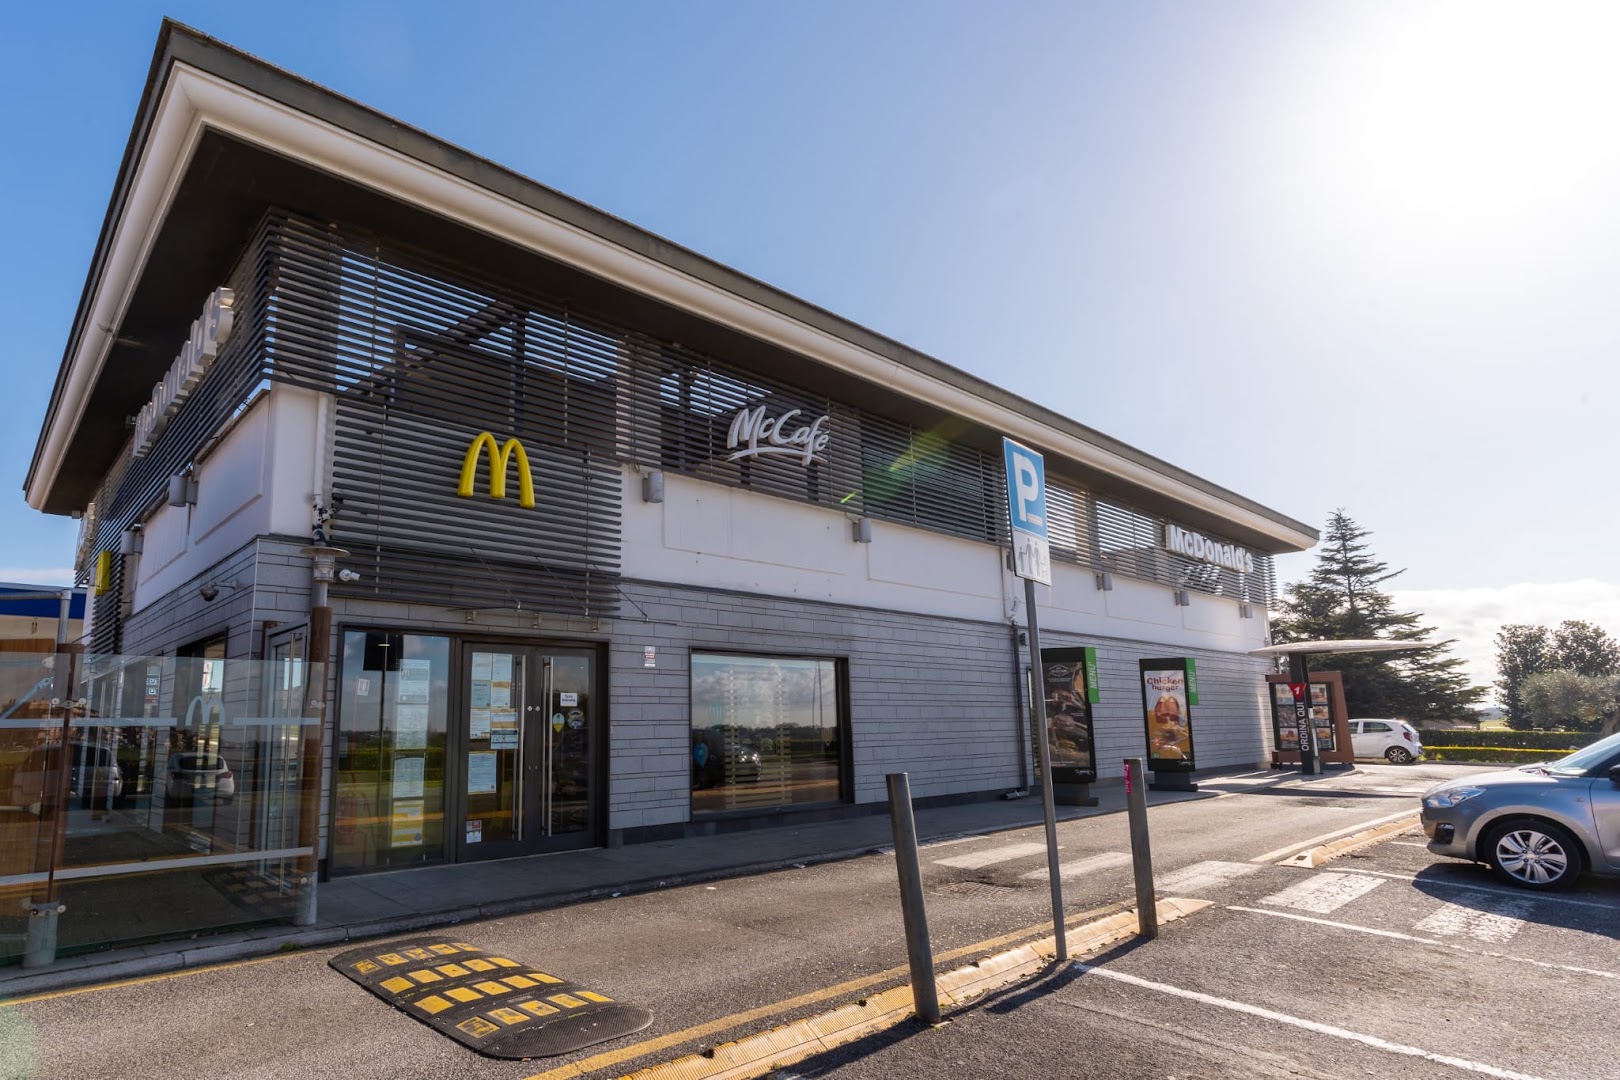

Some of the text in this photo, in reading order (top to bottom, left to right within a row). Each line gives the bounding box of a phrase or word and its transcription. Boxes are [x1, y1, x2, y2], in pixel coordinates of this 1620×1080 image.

[727, 405, 829, 466] McCafé
[1013, 452, 1039, 522] P
[1166, 524, 1254, 574] McDonald's
[1147, 676, 1184, 685] Chicken
[1151, 684, 1180, 692] burger
[1294, 686, 1301, 695] 1
[1296, 702, 1310, 752] ORDINA QUI
